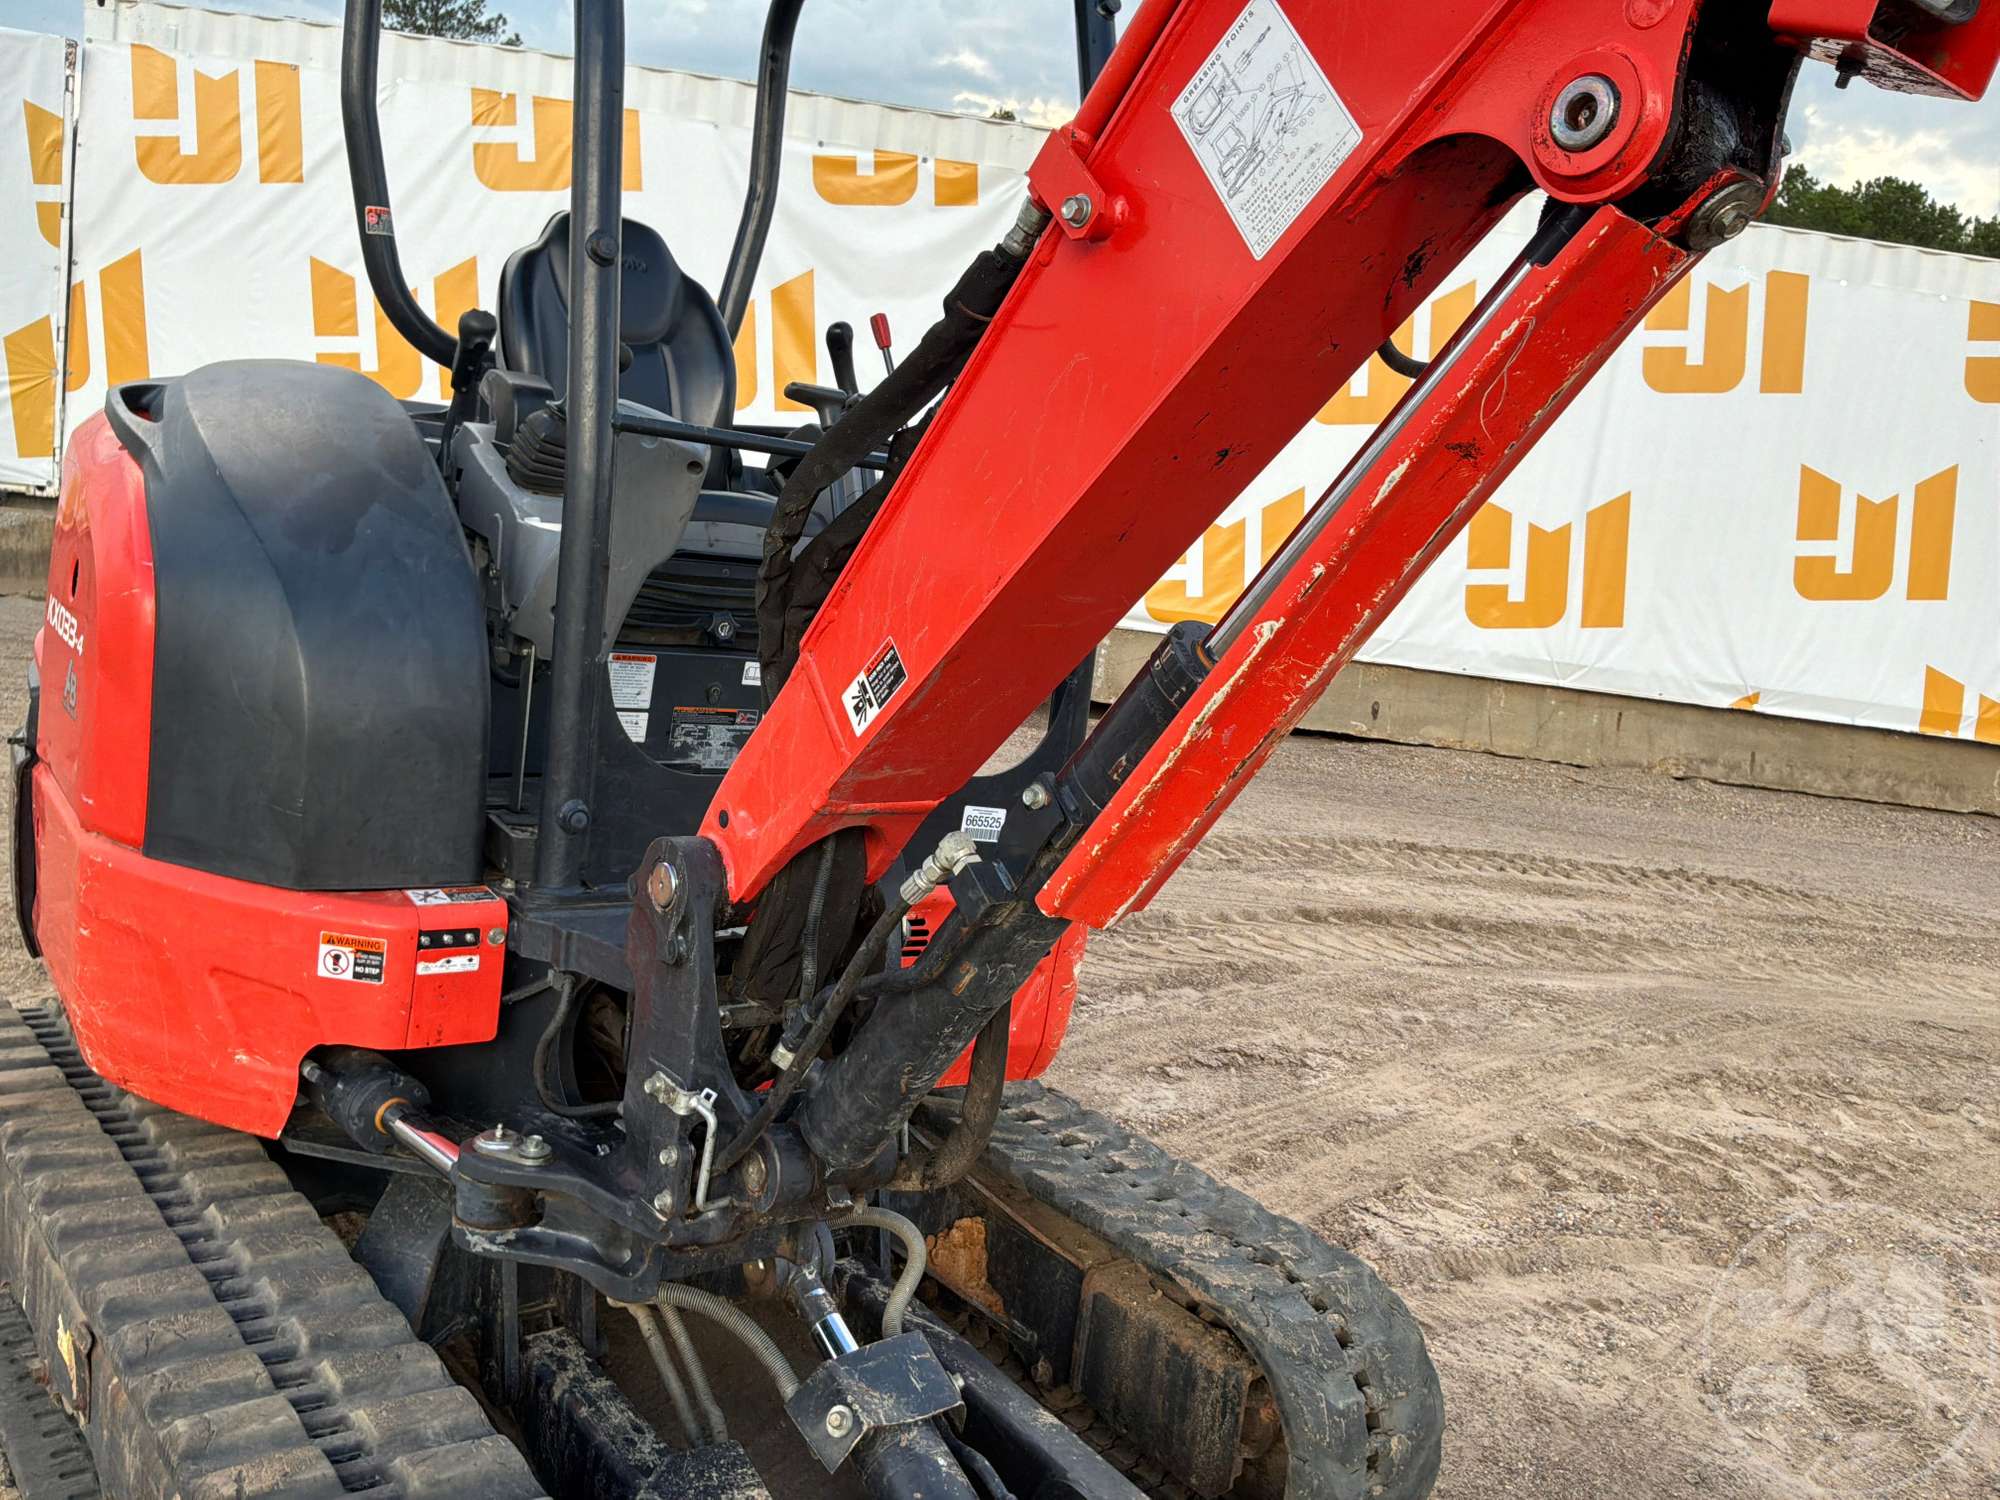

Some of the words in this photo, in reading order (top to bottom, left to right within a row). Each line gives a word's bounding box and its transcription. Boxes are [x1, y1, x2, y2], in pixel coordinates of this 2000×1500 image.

[1183, 53, 1222, 104] GREASING
[1225, 9, 1255, 48] POINTS
[46, 593, 84, 656] KX033-4
[965, 814, 1002, 829] 665525
[336, 935, 381, 950] WARNING
